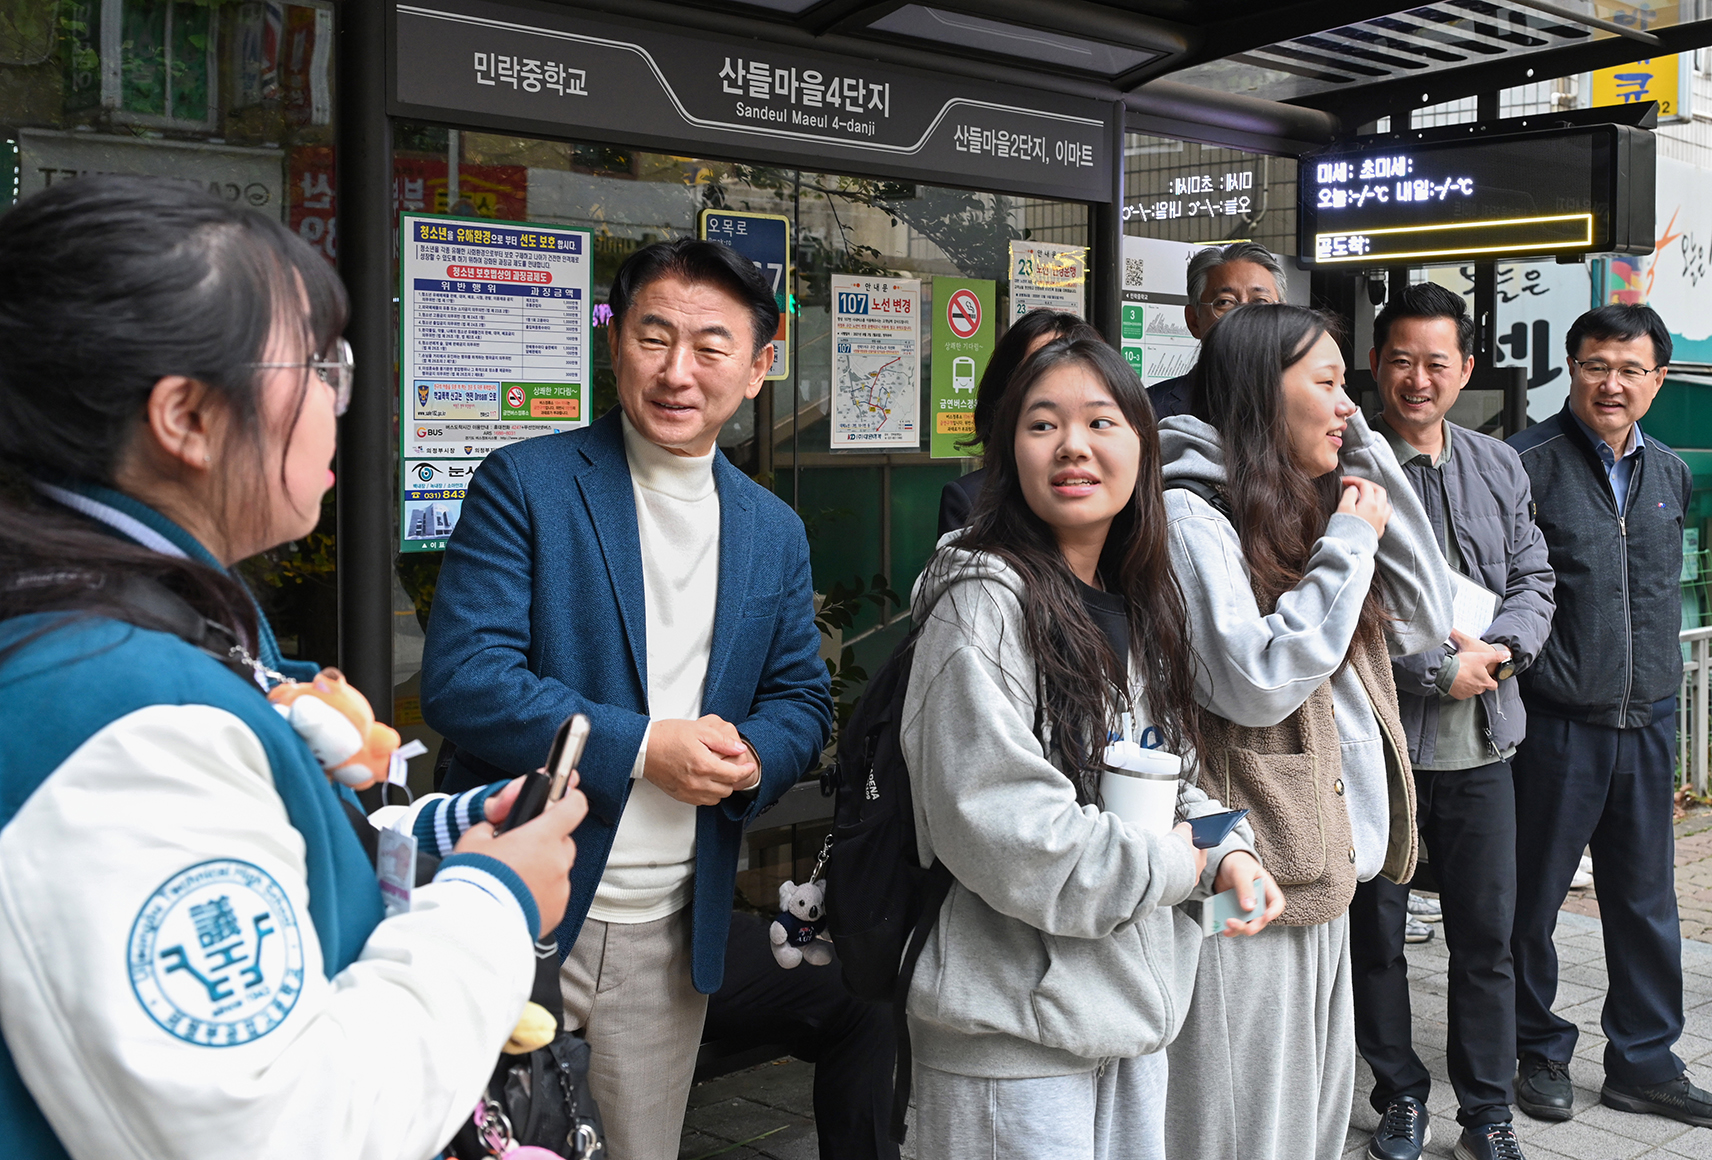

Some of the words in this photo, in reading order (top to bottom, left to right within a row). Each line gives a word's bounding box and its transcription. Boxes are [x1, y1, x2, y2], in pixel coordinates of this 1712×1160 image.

[474, 52, 588, 96] 민락중학교
[718, 57, 890, 118] 산들마을4단지
[736, 102, 787, 123] Sandeul
[792, 110, 827, 129] Maeul
[832, 116, 875, 136] 4-danji
[954, 125, 1049, 164] 산들마을2단지,
[1055, 140, 1093, 167] 이마트
[1317, 164, 1354, 184] 미세:
[1360, 156, 1413, 180] 초미세:
[708, 218, 748, 237] 오목로
[420, 225, 453, 241] 청소년을
[456, 228, 504, 244] 유해환경으로
[505, 236, 517, 246] 부터
[520, 234, 536, 247] 선도
[540, 236, 555, 248] 보호
[557, 240, 576, 250] 합시다.
[453, 266, 474, 277] 청소년
[476, 268, 511, 280] 보호법상의
[513, 271, 546, 282] 과징금제도
[1018, 259, 1033, 276] 23
[840, 294, 867, 313] 107
[872, 299, 890, 312] 노선
[893, 299, 911, 313] 변경
[1017, 304, 1026, 314] 23
[1130, 310, 1135, 320] 3
[838, 344, 850, 352] 107
[1125, 351, 1140, 361] 10-3
[533, 387, 552, 395] 상쾌한
